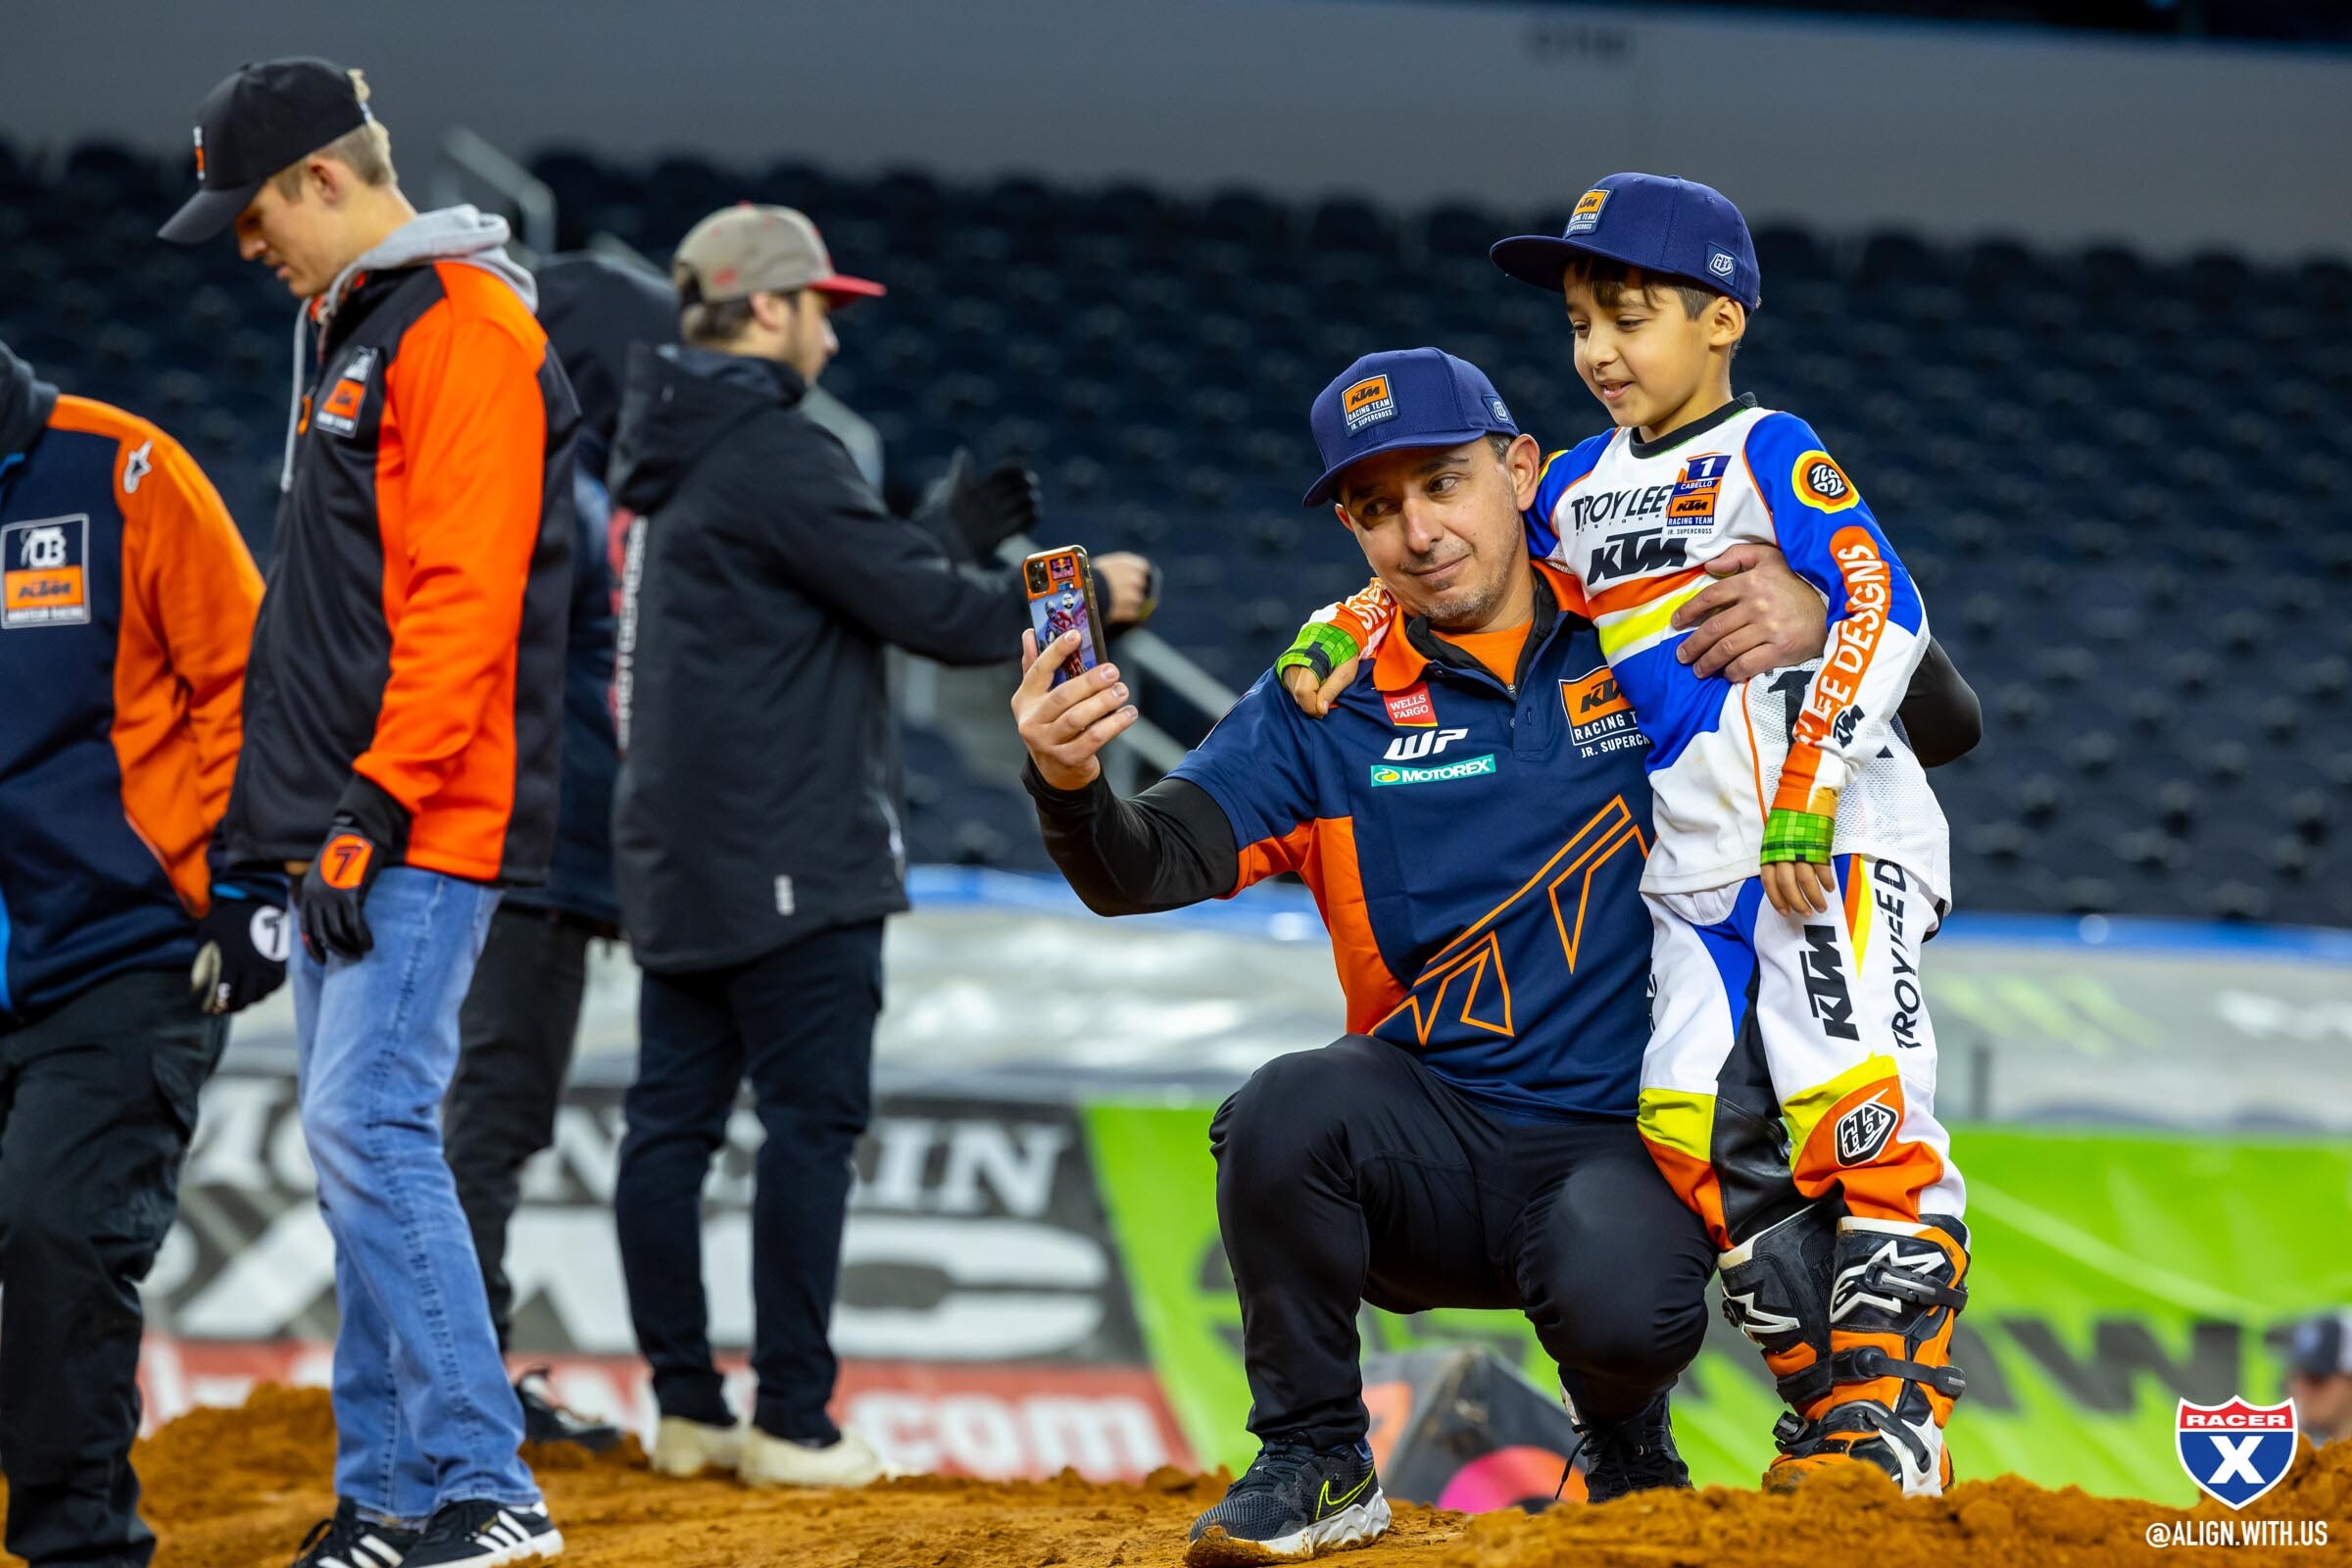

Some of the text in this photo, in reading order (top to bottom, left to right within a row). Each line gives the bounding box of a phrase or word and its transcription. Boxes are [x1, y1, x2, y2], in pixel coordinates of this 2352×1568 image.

[1351, 385, 1380, 406] KTM
[1348, 398, 1391, 421] RACING TEAM
[1358, 409, 1393, 426] SUPERCROSS
[1700, 458, 1716, 477] 1
[1681, 480, 1713, 491] CABELLO
[1571, 484, 1675, 531] TROY LEE
[1676, 499, 1708, 512] KTM
[1668, 516, 1713, 526] RACING TEAM
[1587, 526, 1689, 587] KTM
[1834, 544, 1887, 676] DESIGNS
[1390, 694, 1427, 711] WELLS
[1394, 705, 1429, 719] FARGO
[1574, 713, 1626, 741] RACING
[1383, 728, 1469, 760] WP
[1581, 746, 1598, 759] JR.
[1401, 760, 1491, 783] MOTOREX
[336, 846, 363, 881] 7
[1798, 924, 1860, 1042] KTM
